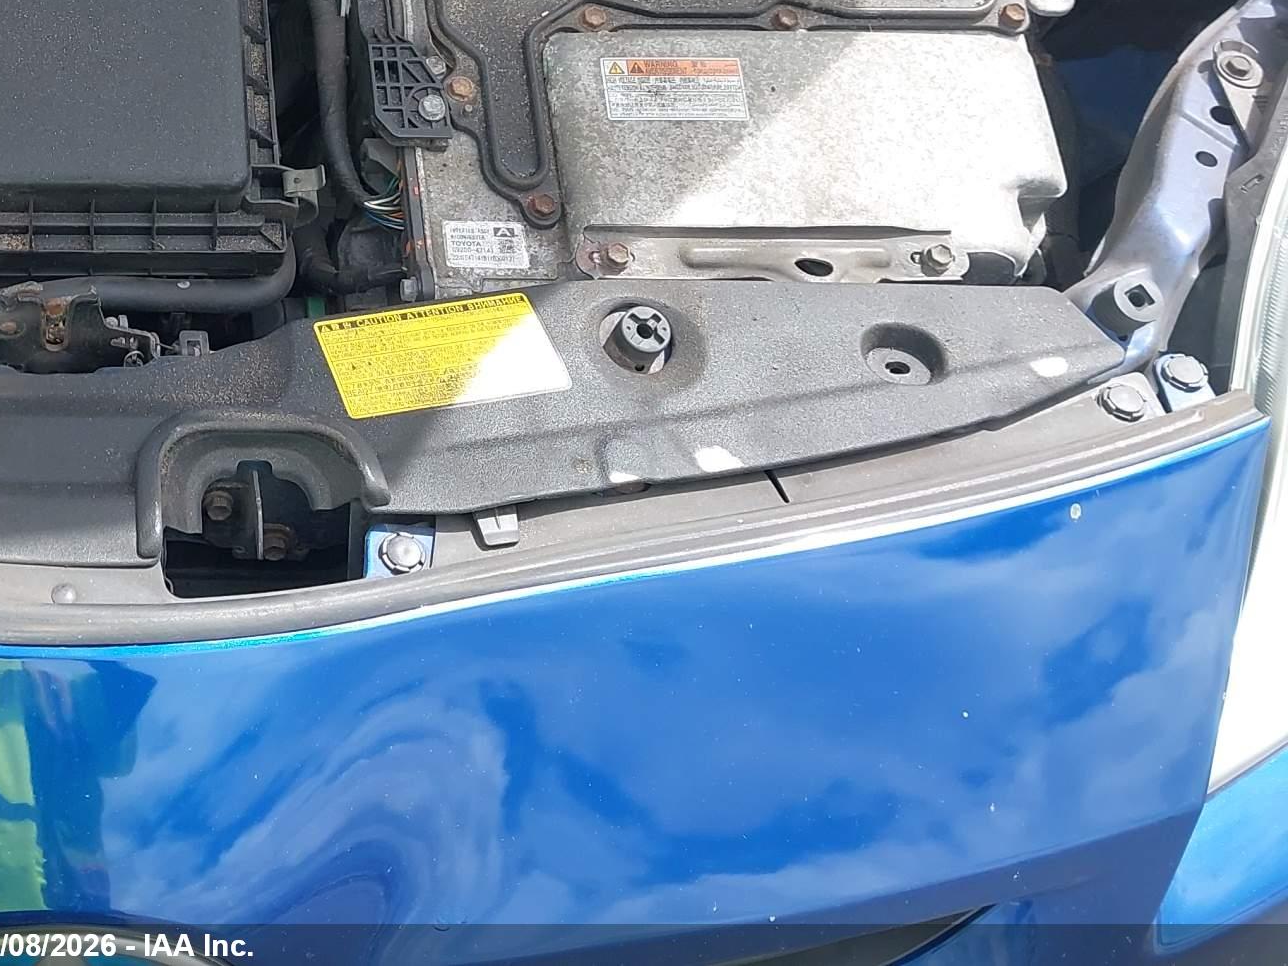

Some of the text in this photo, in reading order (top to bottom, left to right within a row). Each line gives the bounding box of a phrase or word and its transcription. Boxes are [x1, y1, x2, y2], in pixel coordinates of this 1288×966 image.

[356, 313, 402, 327] CAUTION
[407, 305, 464, 321] ATTENTION
[467, 295, 524, 313] ВНИМАНИЕ
